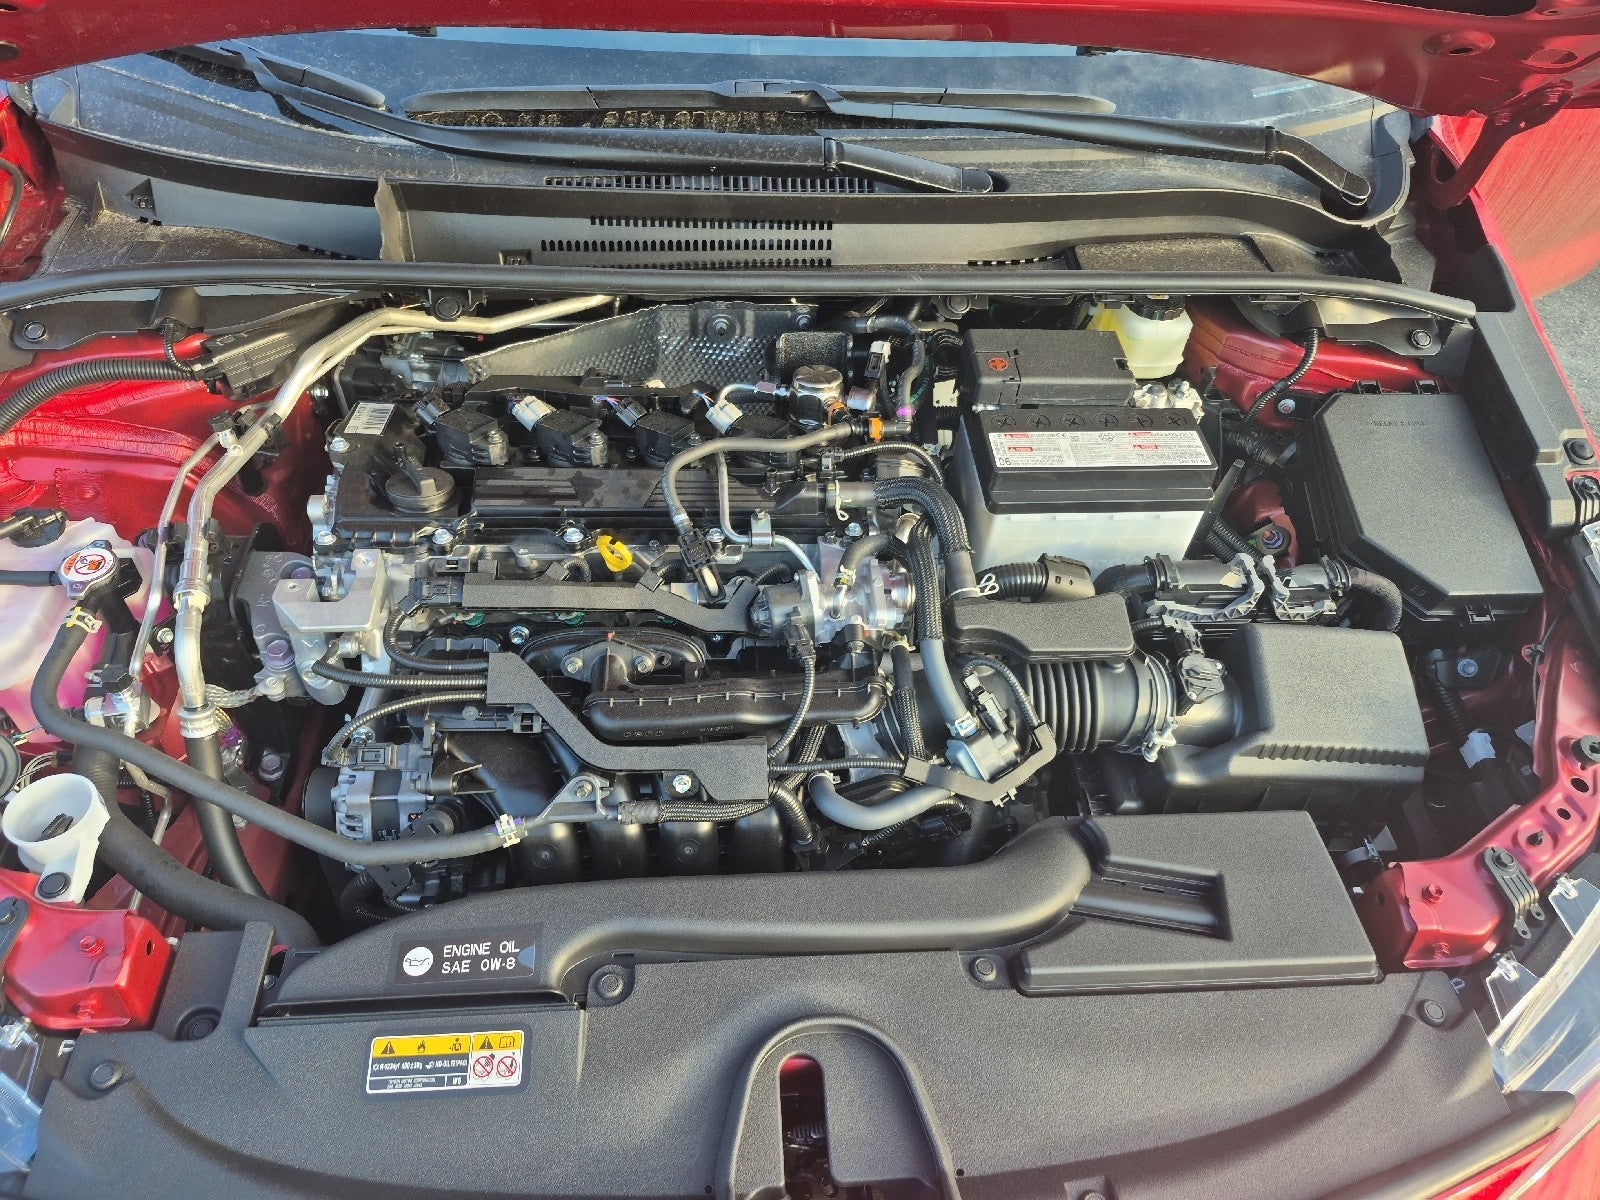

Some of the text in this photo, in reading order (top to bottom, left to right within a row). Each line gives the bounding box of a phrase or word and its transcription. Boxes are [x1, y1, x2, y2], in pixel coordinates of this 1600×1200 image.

[443, 939, 520, 958] ENGINE OIL
[441, 957, 516, 974] SAE 0W-8
